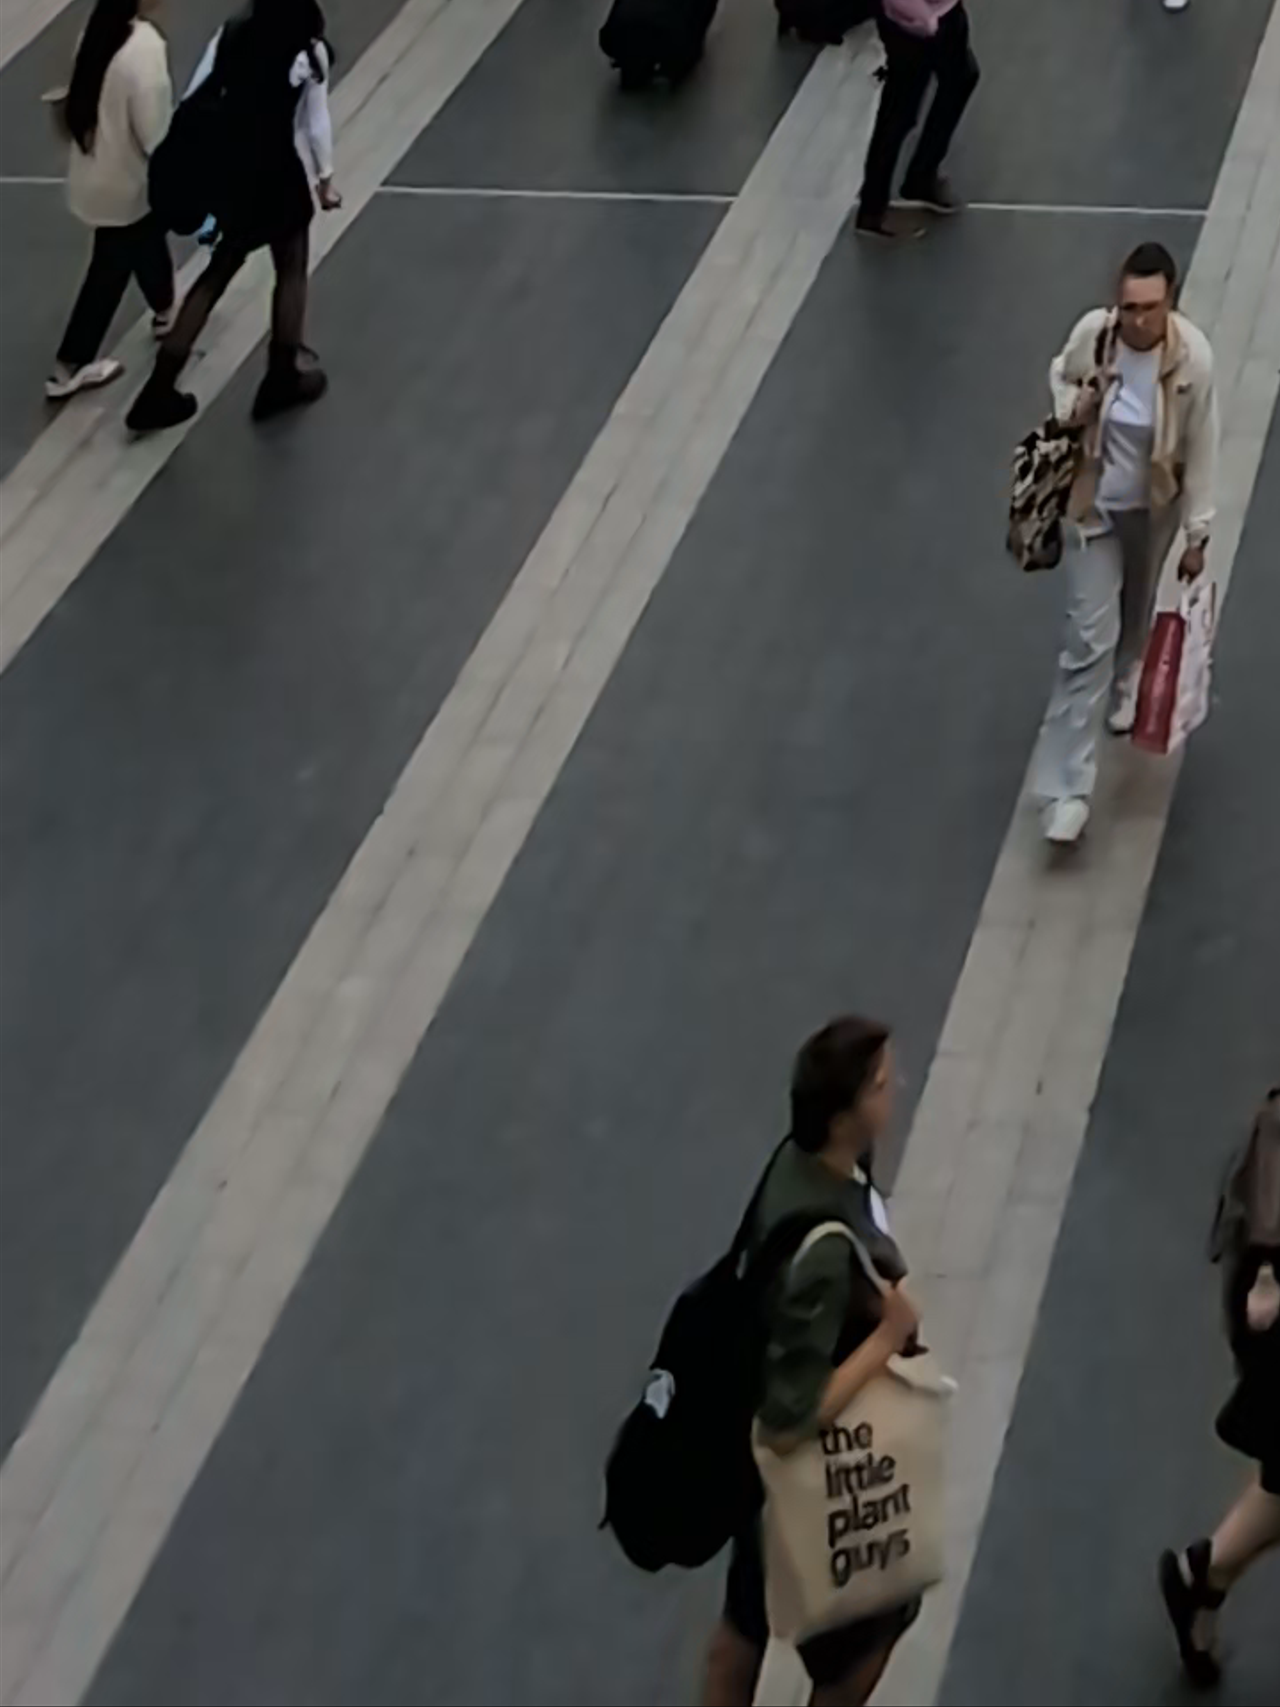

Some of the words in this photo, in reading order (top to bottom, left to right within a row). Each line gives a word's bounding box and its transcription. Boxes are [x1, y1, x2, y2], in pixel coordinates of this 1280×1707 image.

[819, 1420, 873, 1456] the
[825, 1452, 896, 1500] little
[828, 1483, 911, 1550] plant
[830, 1529, 911, 1589] guys
